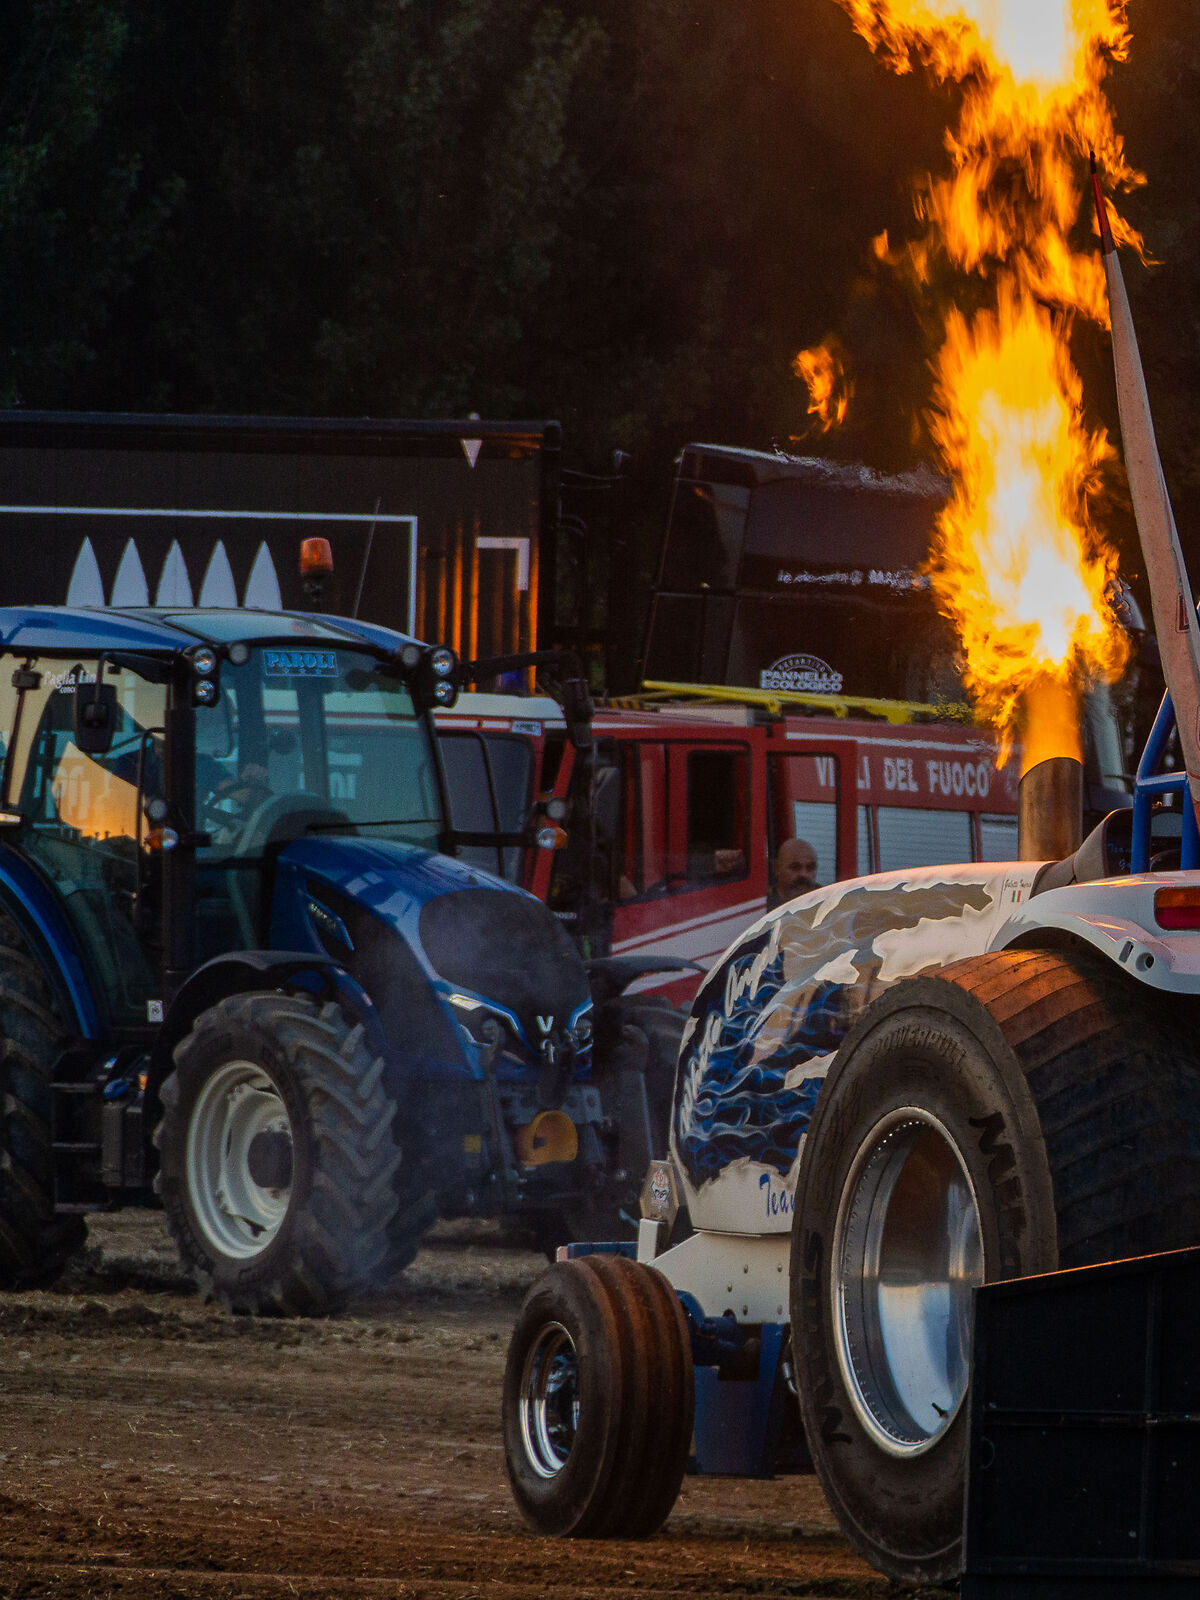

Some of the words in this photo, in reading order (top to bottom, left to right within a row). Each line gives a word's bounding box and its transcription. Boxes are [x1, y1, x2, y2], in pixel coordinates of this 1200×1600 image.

[266, 653, 335, 668] PAROLI
[761, 669, 843, 682] PANNELLO
[761, 679, 843, 692] ECOLOGICO
[883, 756, 919, 793] DEL
[926, 760, 990, 798] FUOCO
